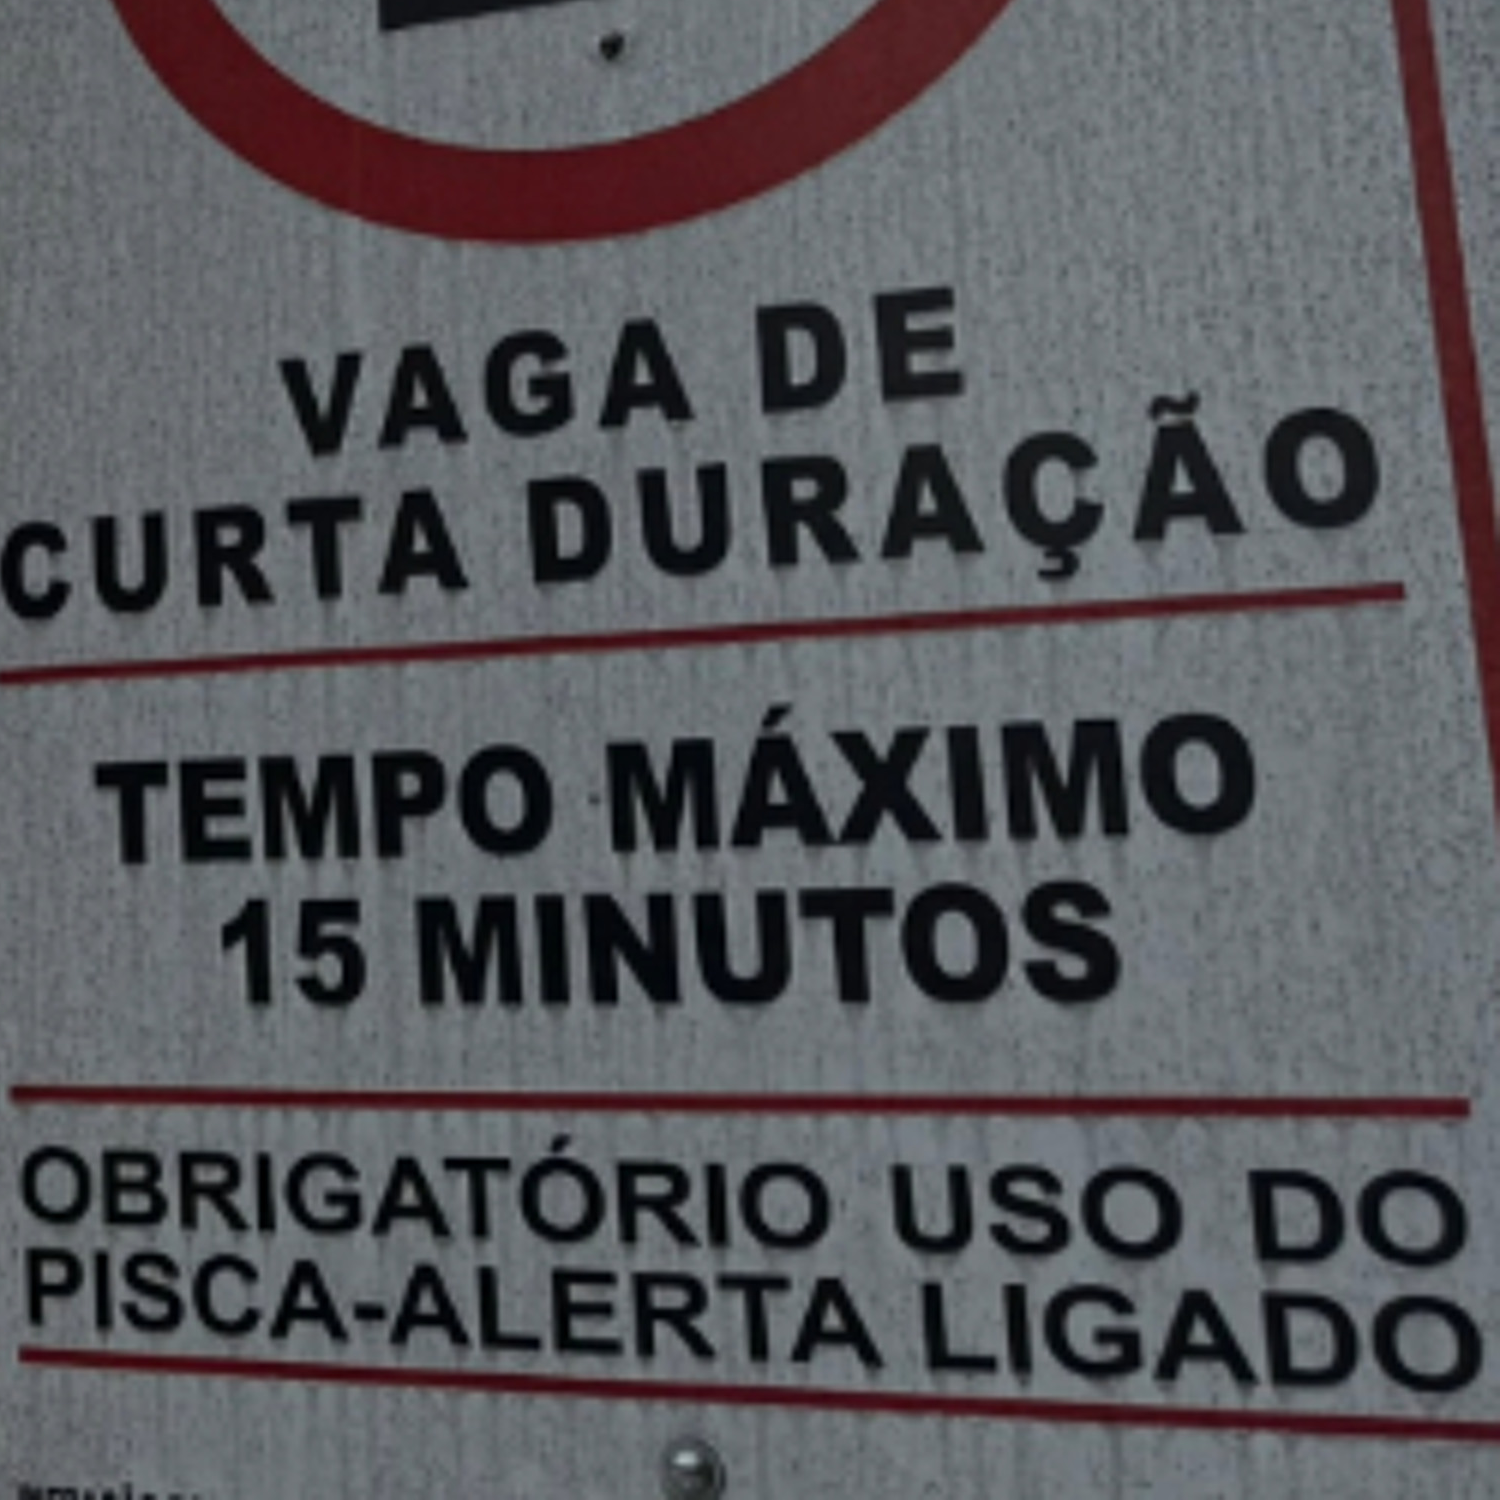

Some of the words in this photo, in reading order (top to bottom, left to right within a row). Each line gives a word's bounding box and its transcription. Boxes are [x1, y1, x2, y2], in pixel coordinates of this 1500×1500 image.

[276, 317, 697, 460] VAGA
[754, 285, 967, 417] DE
[525, 390, 1382, 585] DURAÇÃO
[91, 742, 556, 868] TEMPO
[603, 702, 1258, 858] MÁXIMO
[218, 896, 368, 1012] 15
[413, 878, 1124, 1013] MINUTOS
[18, 1137, 833, 1254] OBRIGATÓRIO
[888, 1162, 1185, 1264] USO
[1246, 1167, 1471, 1271] DO
[23, 1245, 887, 1375] PISCA-ALERTA
[919, 1280, 1486, 1397] LIGADO
